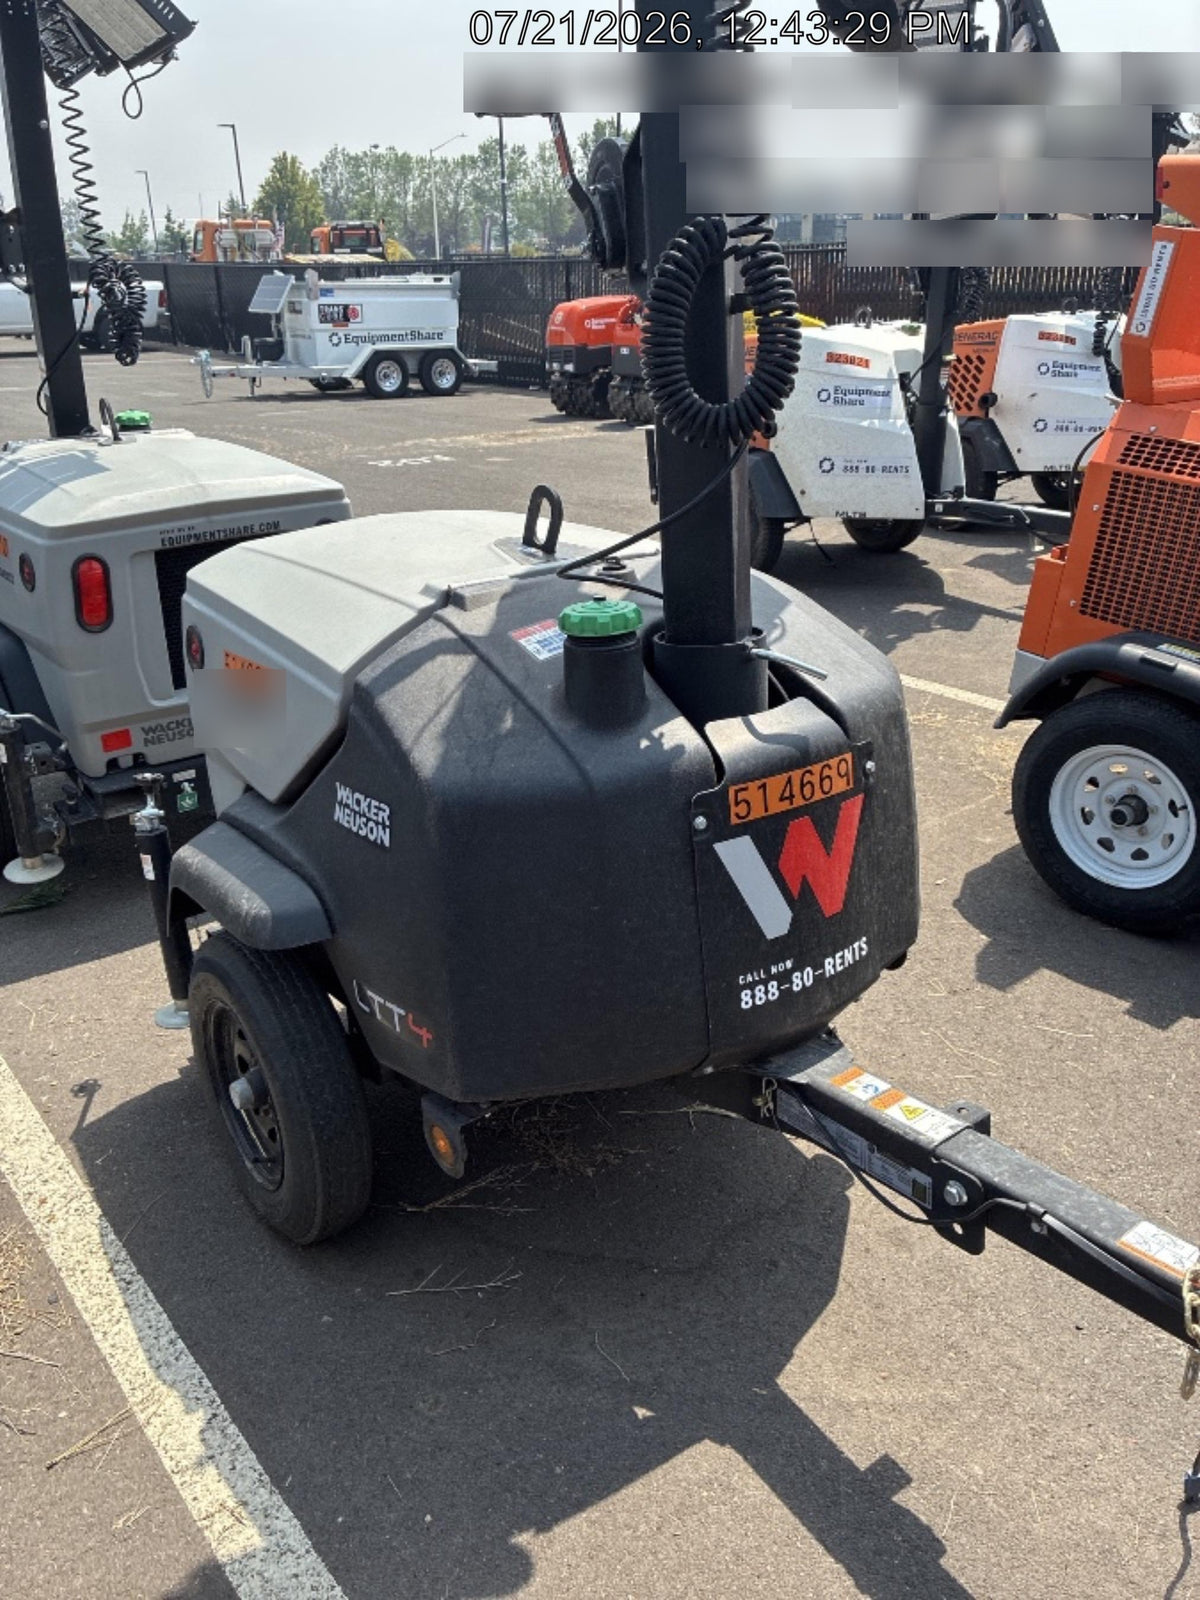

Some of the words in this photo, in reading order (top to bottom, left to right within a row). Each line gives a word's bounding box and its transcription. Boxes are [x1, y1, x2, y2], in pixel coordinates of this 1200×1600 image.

[343, 330, 445, 345] EquipmentShare
[833, 385, 892, 398] Equipment
[833, 396, 865, 406] Share
[335, 781, 390, 826] WACKER
[734, 757, 851, 821] 514669
[334, 802, 390, 848] NEUSON
[739, 968, 766, 985] CALL
[770, 958, 794, 975] NOW
[740, 936, 868, 1010] 888-80-RENTS
[353, 979, 433, 1048] LTT4
